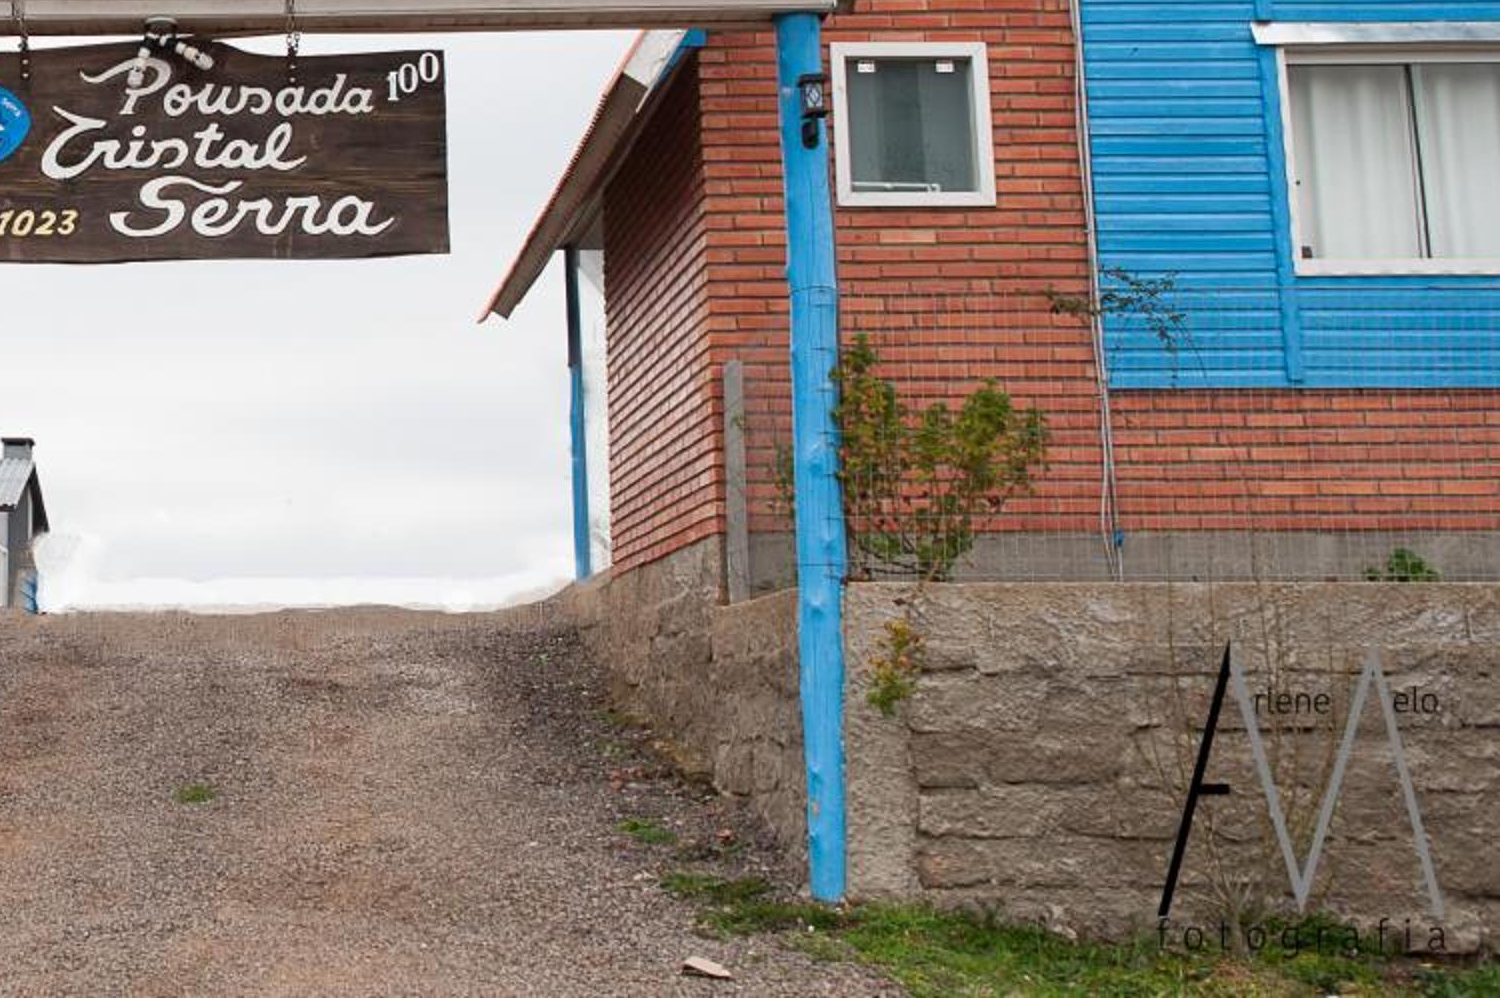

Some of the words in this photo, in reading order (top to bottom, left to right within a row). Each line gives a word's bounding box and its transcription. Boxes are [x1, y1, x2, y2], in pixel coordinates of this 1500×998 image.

[79, 58, 375, 116] Pousada
[387, 52, 439, 101] 100
[41, 105, 307, 180] Cristal
[109, 175, 395, 237] Serra
